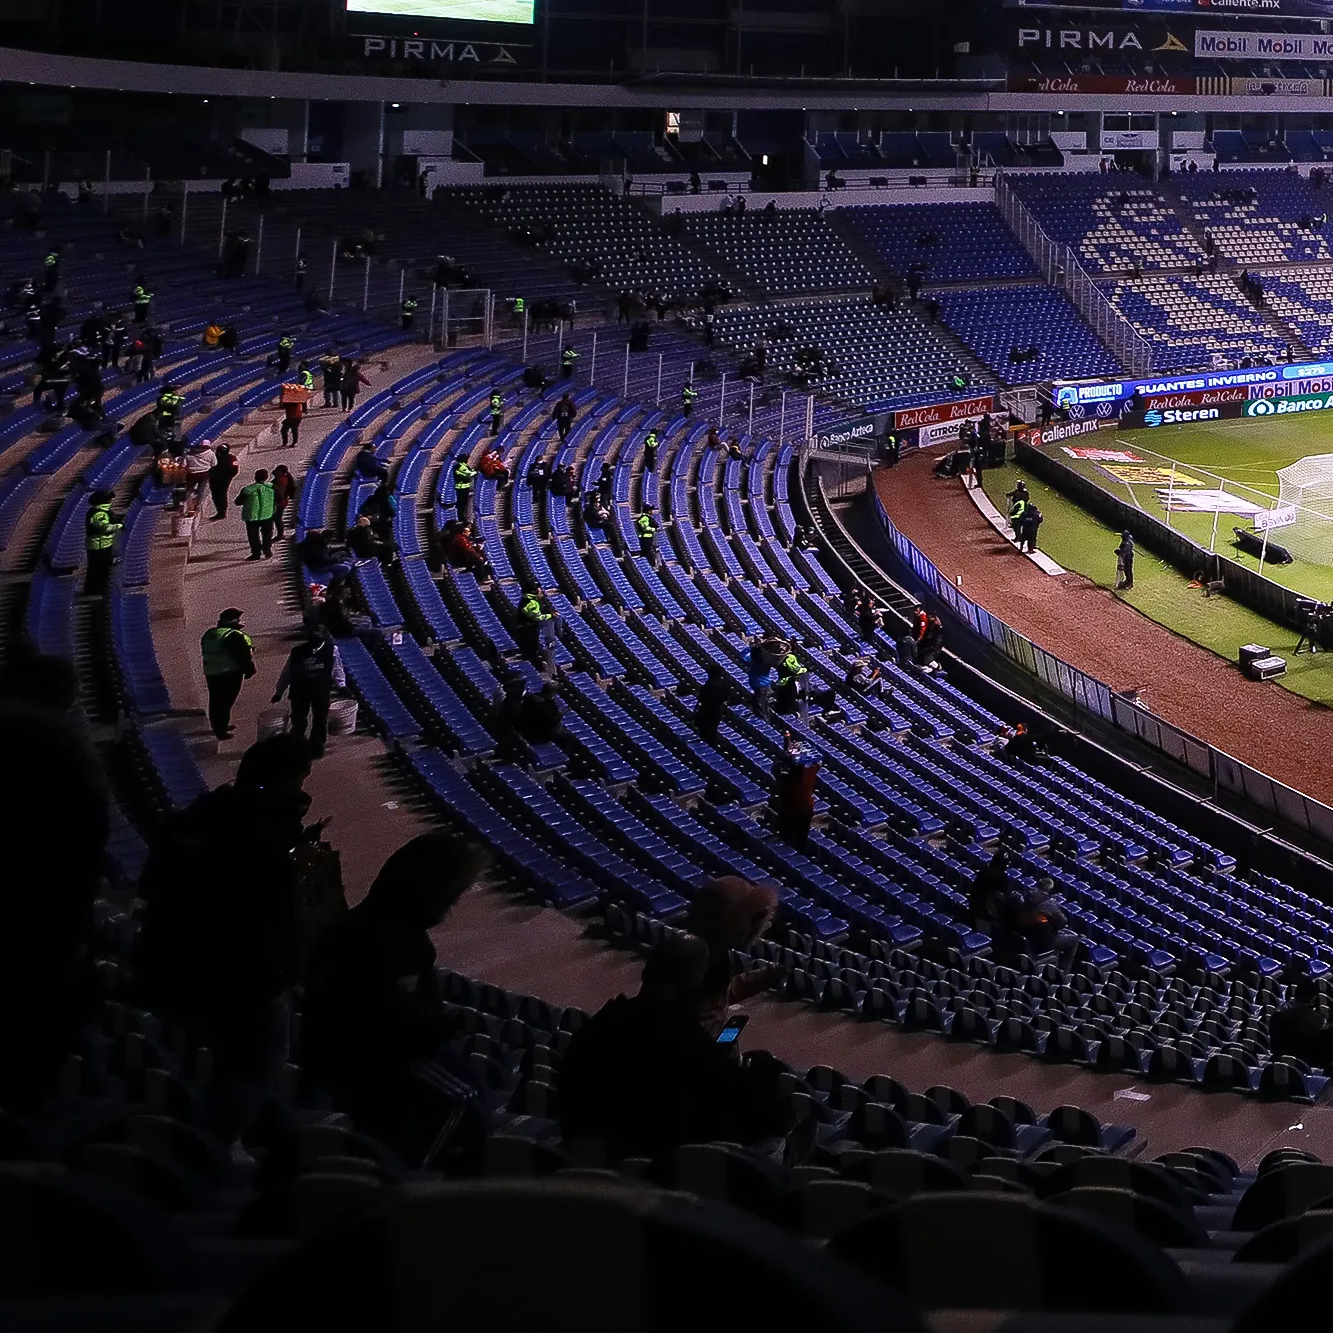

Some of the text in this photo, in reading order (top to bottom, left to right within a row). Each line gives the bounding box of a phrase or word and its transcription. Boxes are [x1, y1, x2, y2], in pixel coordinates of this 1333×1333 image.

[1019, 29, 1142, 50] PIRMA
[1202, 37, 1246, 52] Mobil
[1258, 37, 1302, 54] Mobil
[364, 38, 479, 62] PIRMA
[1208, 372, 1276, 386] INVIERNO
[1079, 384, 1122, 399] PRODUCTO
[1251, 384, 1294, 401] Mobil
[1164, 407, 1219, 423] Steren
[1277, 400, 1319, 413] Banco
[1042, 419, 1098, 444] caliente.mx
